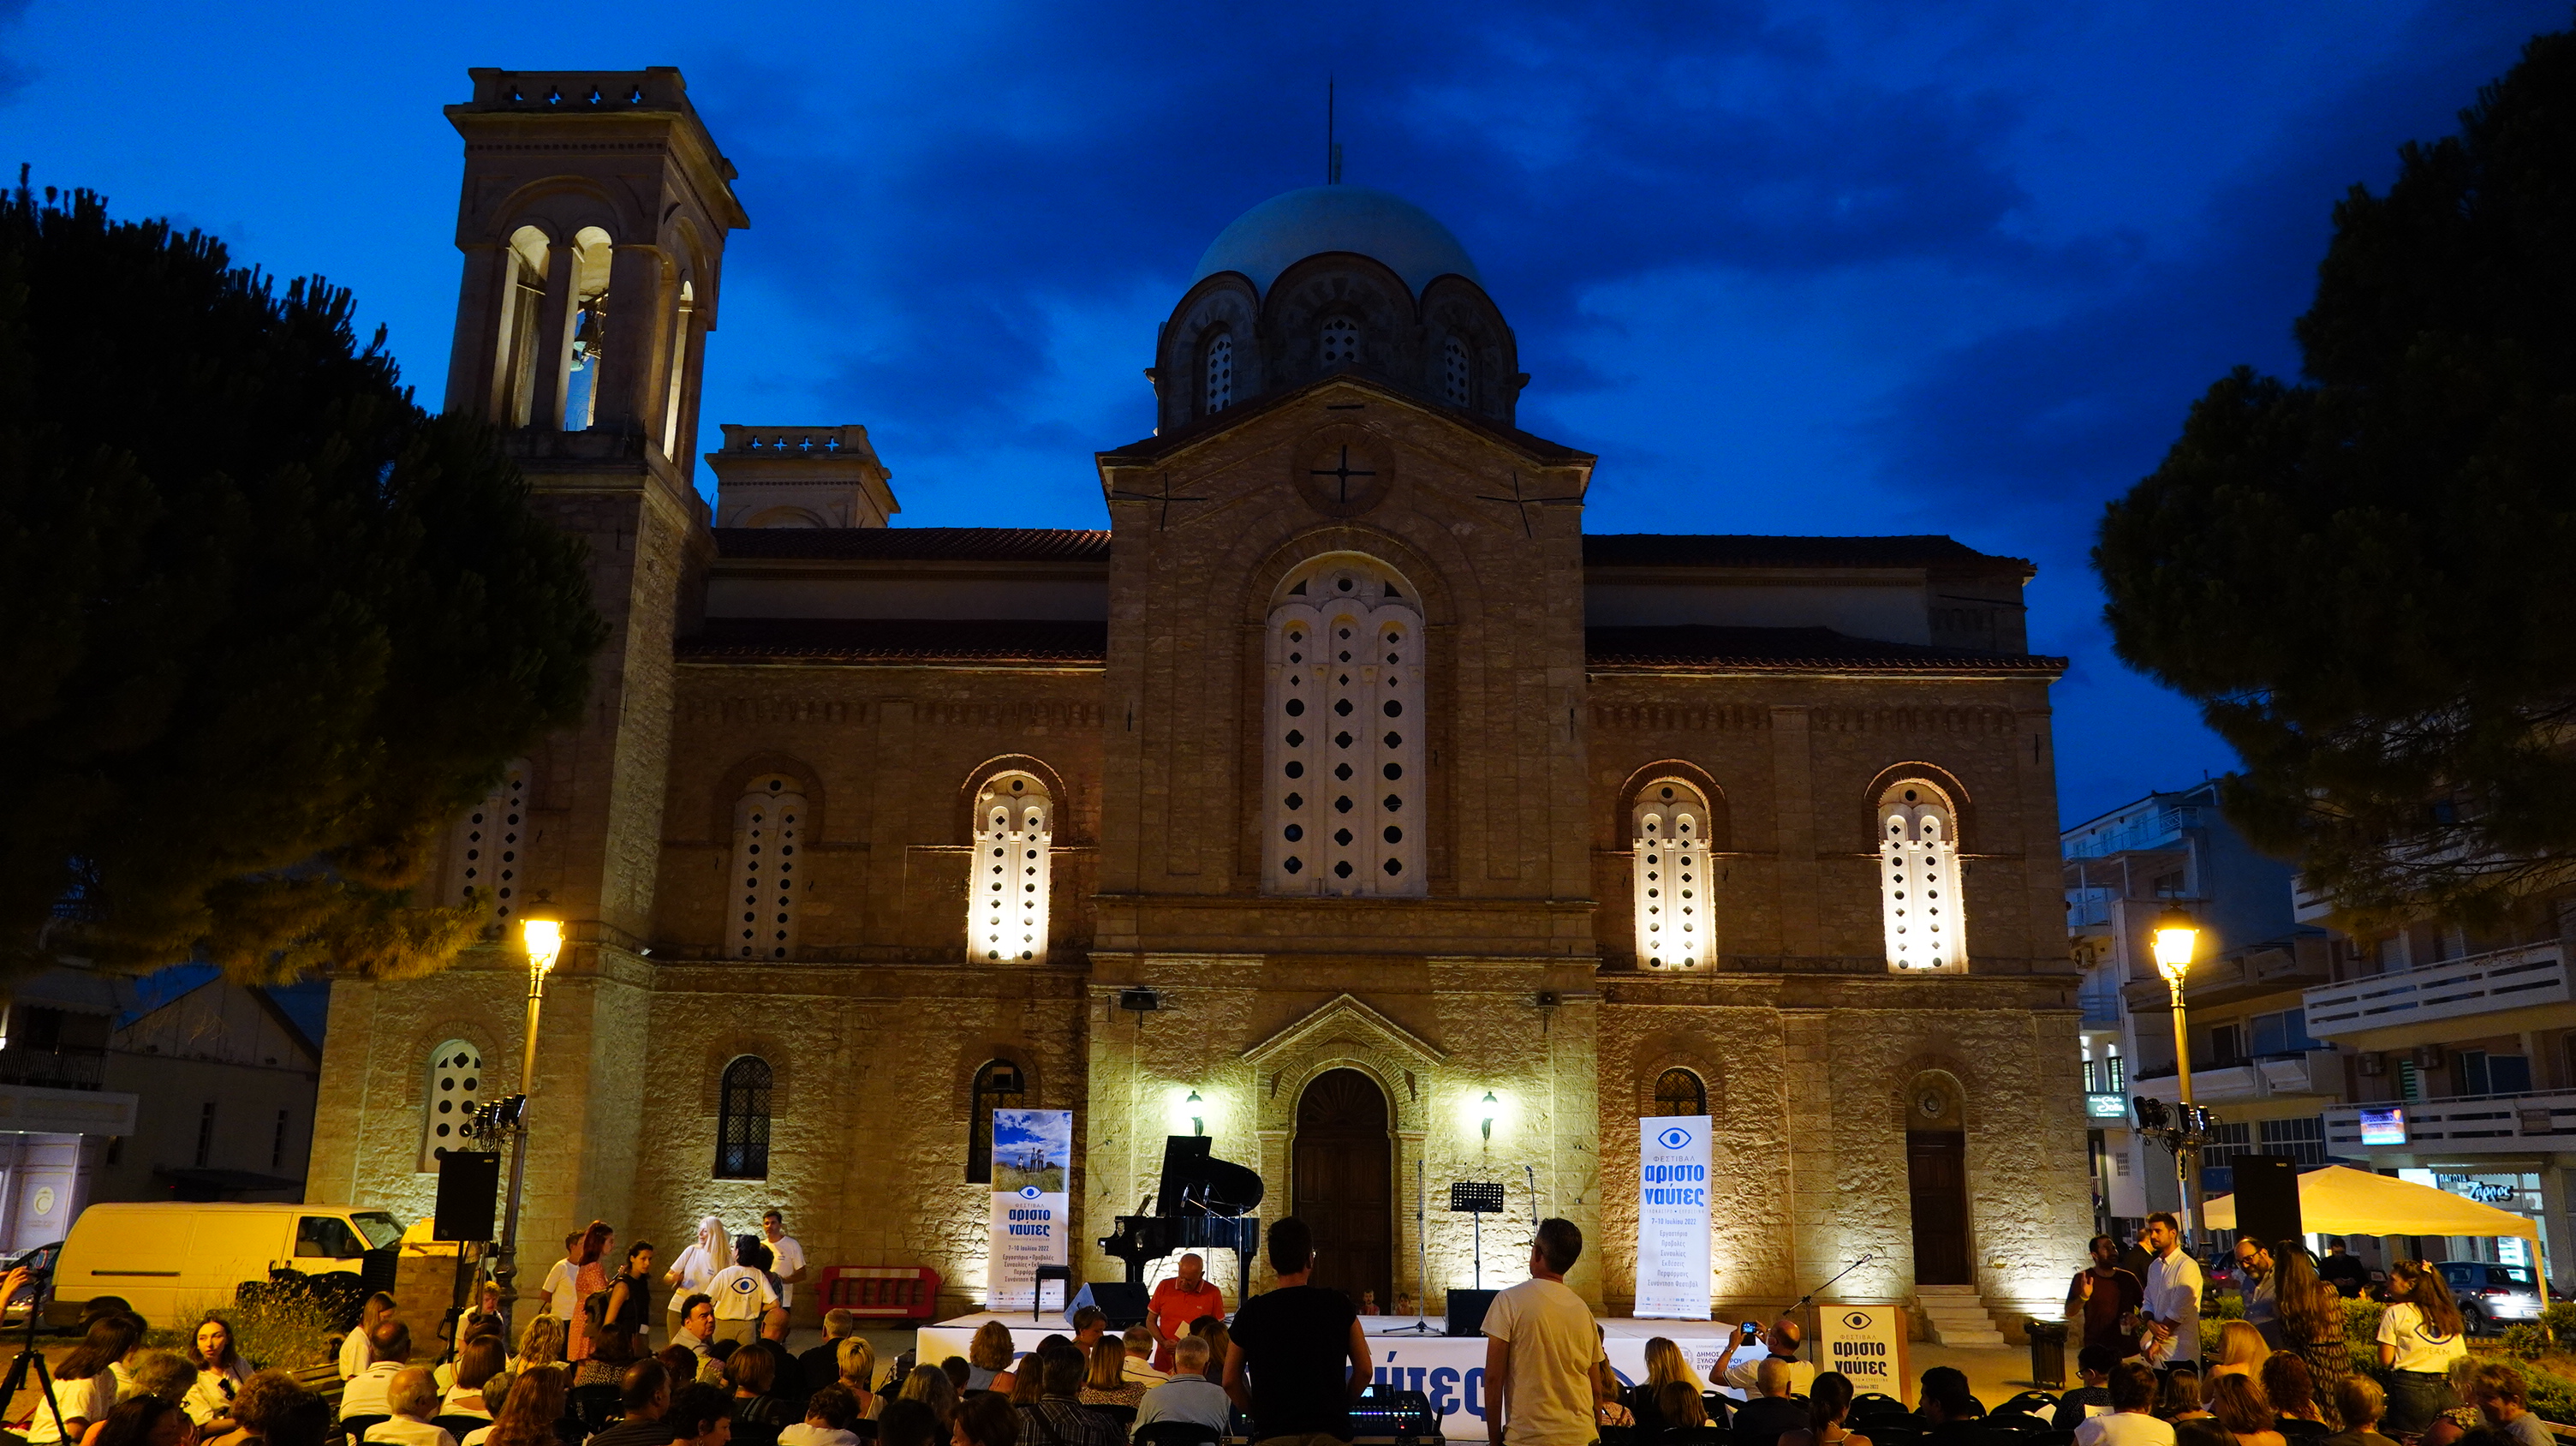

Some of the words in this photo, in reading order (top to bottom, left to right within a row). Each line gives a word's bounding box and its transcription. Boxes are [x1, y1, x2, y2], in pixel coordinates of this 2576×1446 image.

[1644, 1164, 1704, 1184] αριστο
[1644, 1183, 1704, 1207] ναύτες
[1009, 1209, 1051, 1222] αριστο
[1009, 1222, 1051, 1237] ναύτες
[1834, 1341, 1886, 1357] αριστο
[1834, 1357, 1887, 1377] ναύτες
